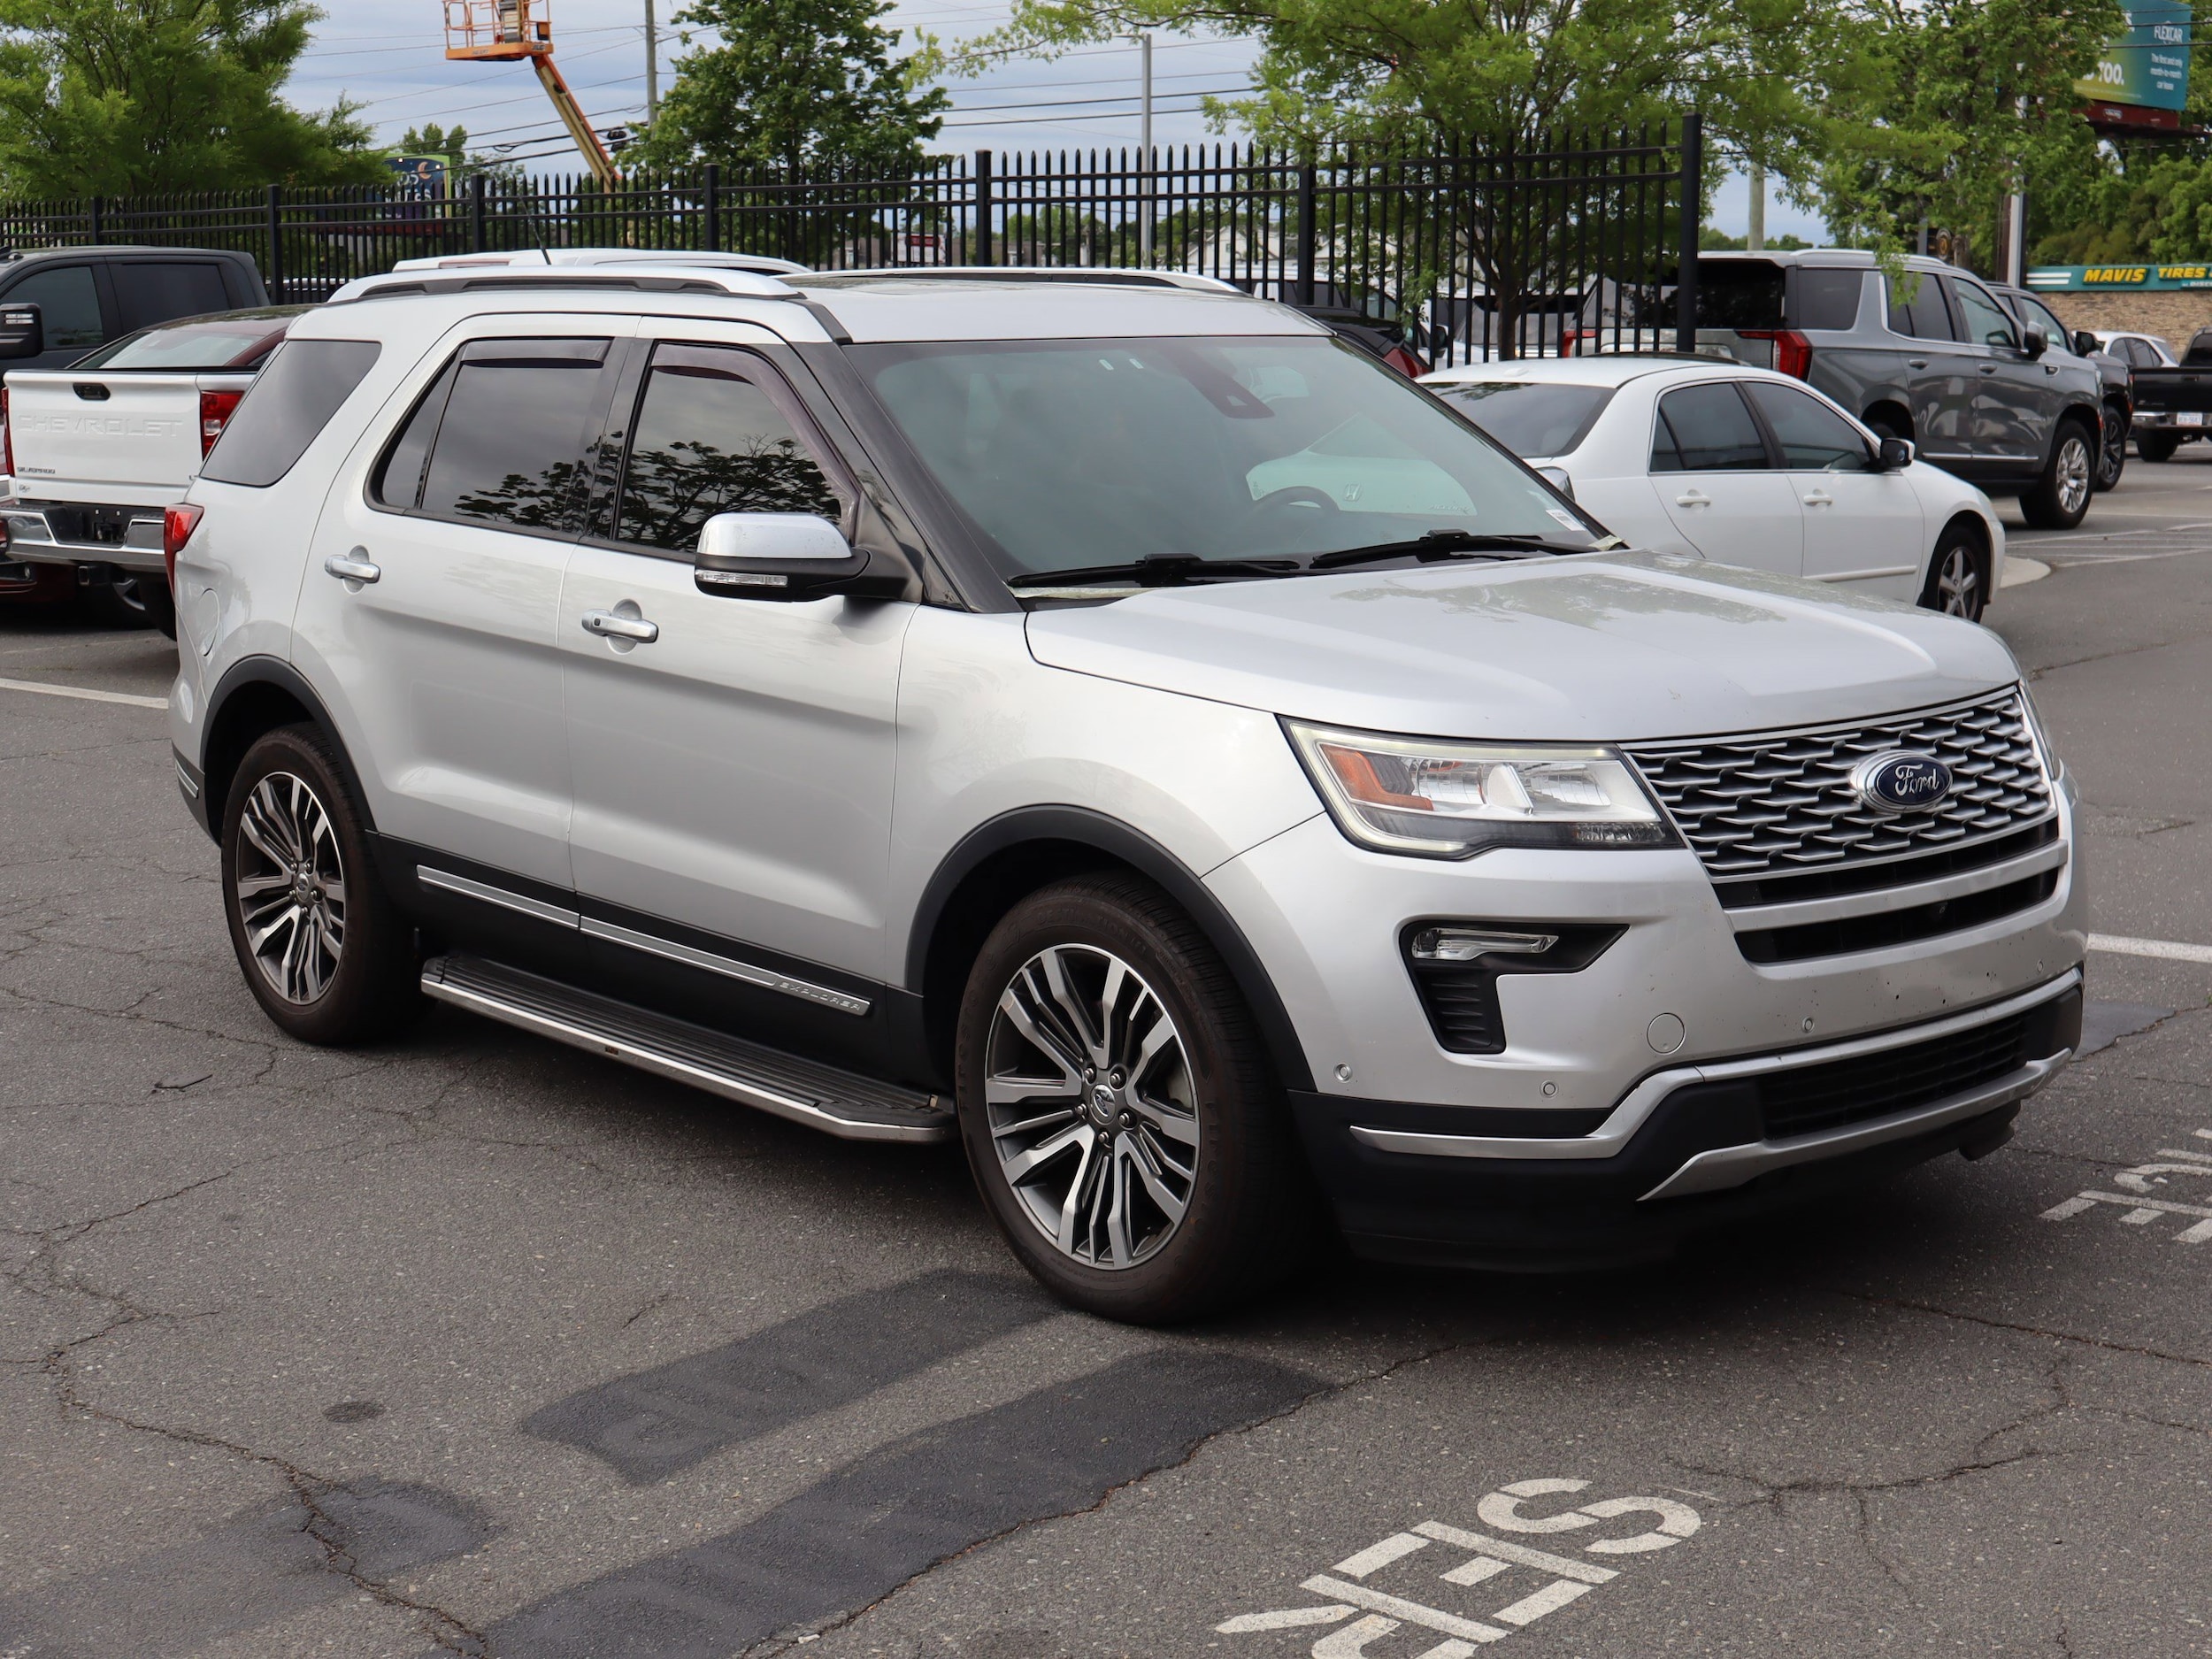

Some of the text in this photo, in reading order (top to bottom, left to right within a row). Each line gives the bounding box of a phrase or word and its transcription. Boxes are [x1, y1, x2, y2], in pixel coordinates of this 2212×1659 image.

[2154, 25, 2184, 43] FLEXCAR
[2083, 267, 2206, 282] MAVIS TIRES
[17, 413, 184, 438] CHEVROLET
[1894, 763, 1940, 796] Ford
